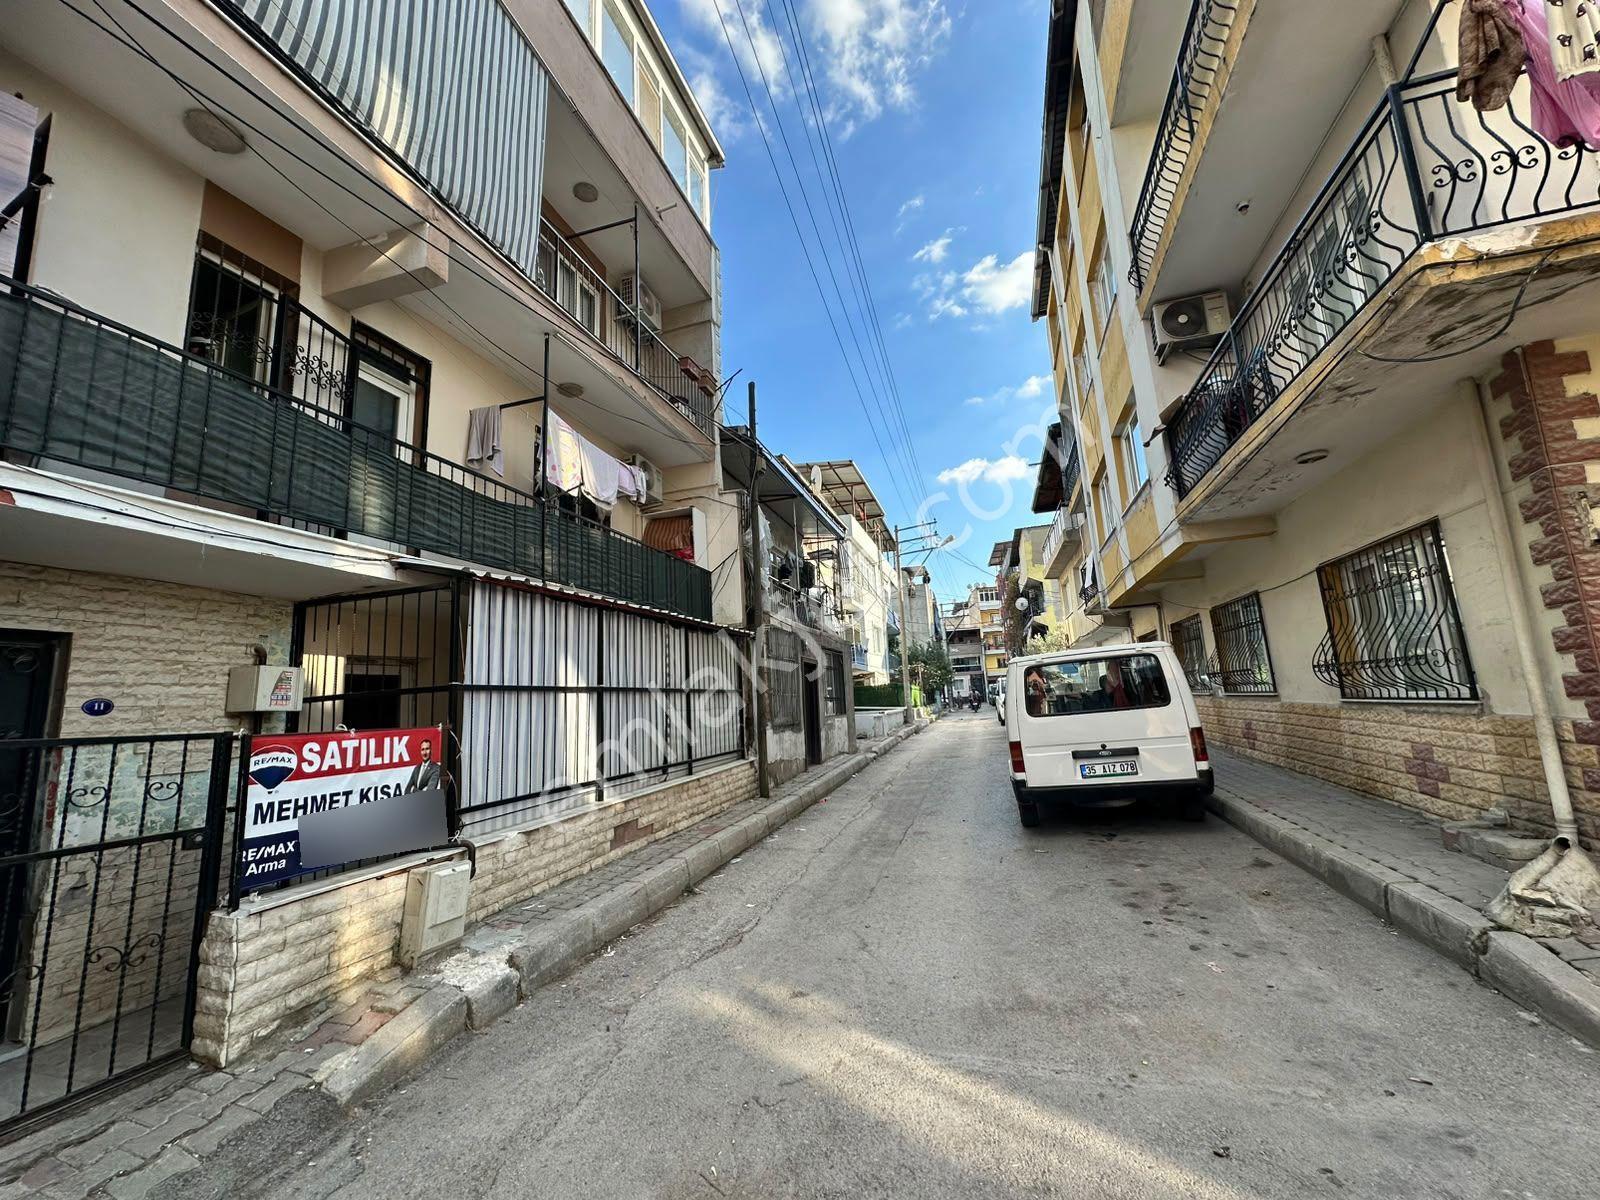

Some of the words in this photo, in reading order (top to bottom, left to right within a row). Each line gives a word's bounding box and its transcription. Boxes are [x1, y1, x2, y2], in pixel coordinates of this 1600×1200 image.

[253, 756, 293, 767] RE/MAX
[301, 735, 411, 773] SATILIK
[1086, 765, 1097, 775] 35
[1102, 764, 1117, 773] AIZ
[1120, 762, 1136, 772] 078
[252, 789, 354, 826] MEHMET
[359, 782, 403, 805] KISA
[245, 858, 287, 877] Arma
